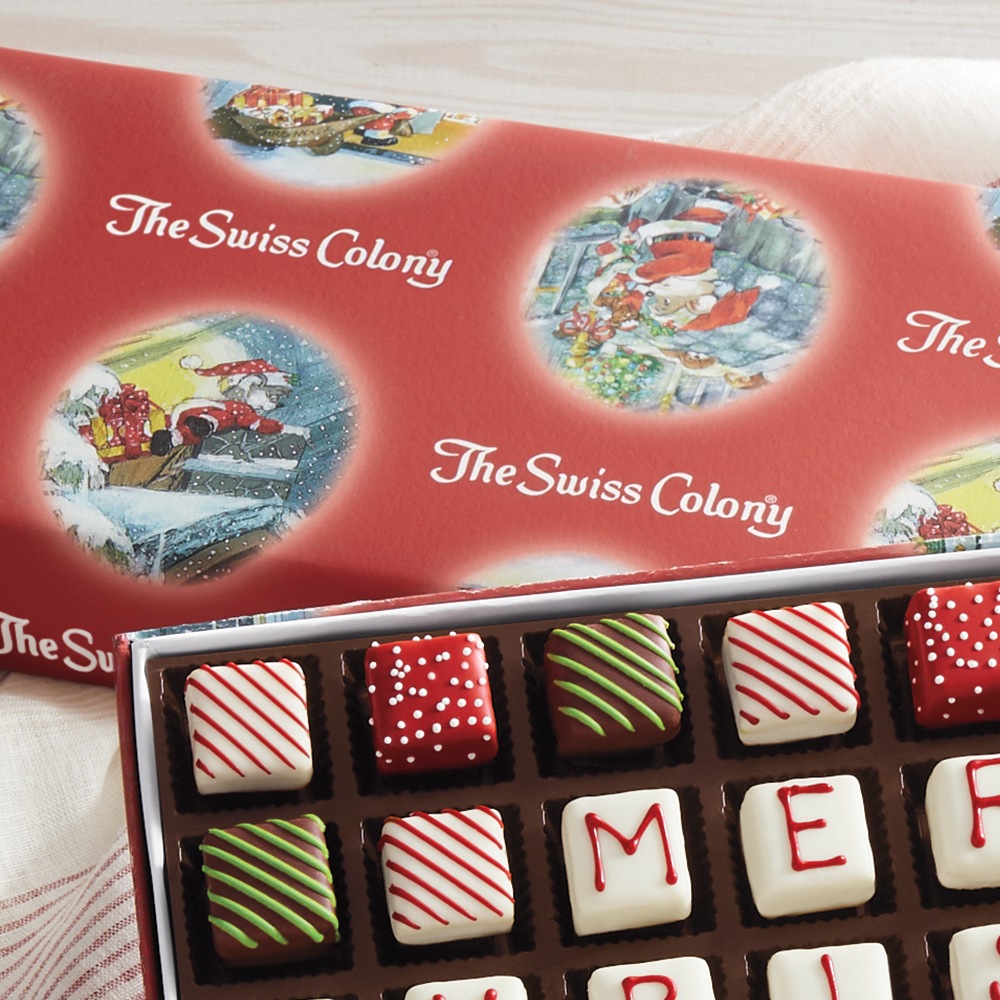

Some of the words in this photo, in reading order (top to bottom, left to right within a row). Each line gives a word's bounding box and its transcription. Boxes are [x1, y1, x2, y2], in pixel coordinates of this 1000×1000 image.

[105, 193, 190, 239] The
[188, 208, 311, 258] Swiss
[316, 228, 453, 289] Colony
[896, 309, 988, 358] The
[430, 438, 517, 486] The
[516, 453, 643, 505] Swiss
[650, 472, 794, 539] Colony
[0, 611, 59, 660] The
